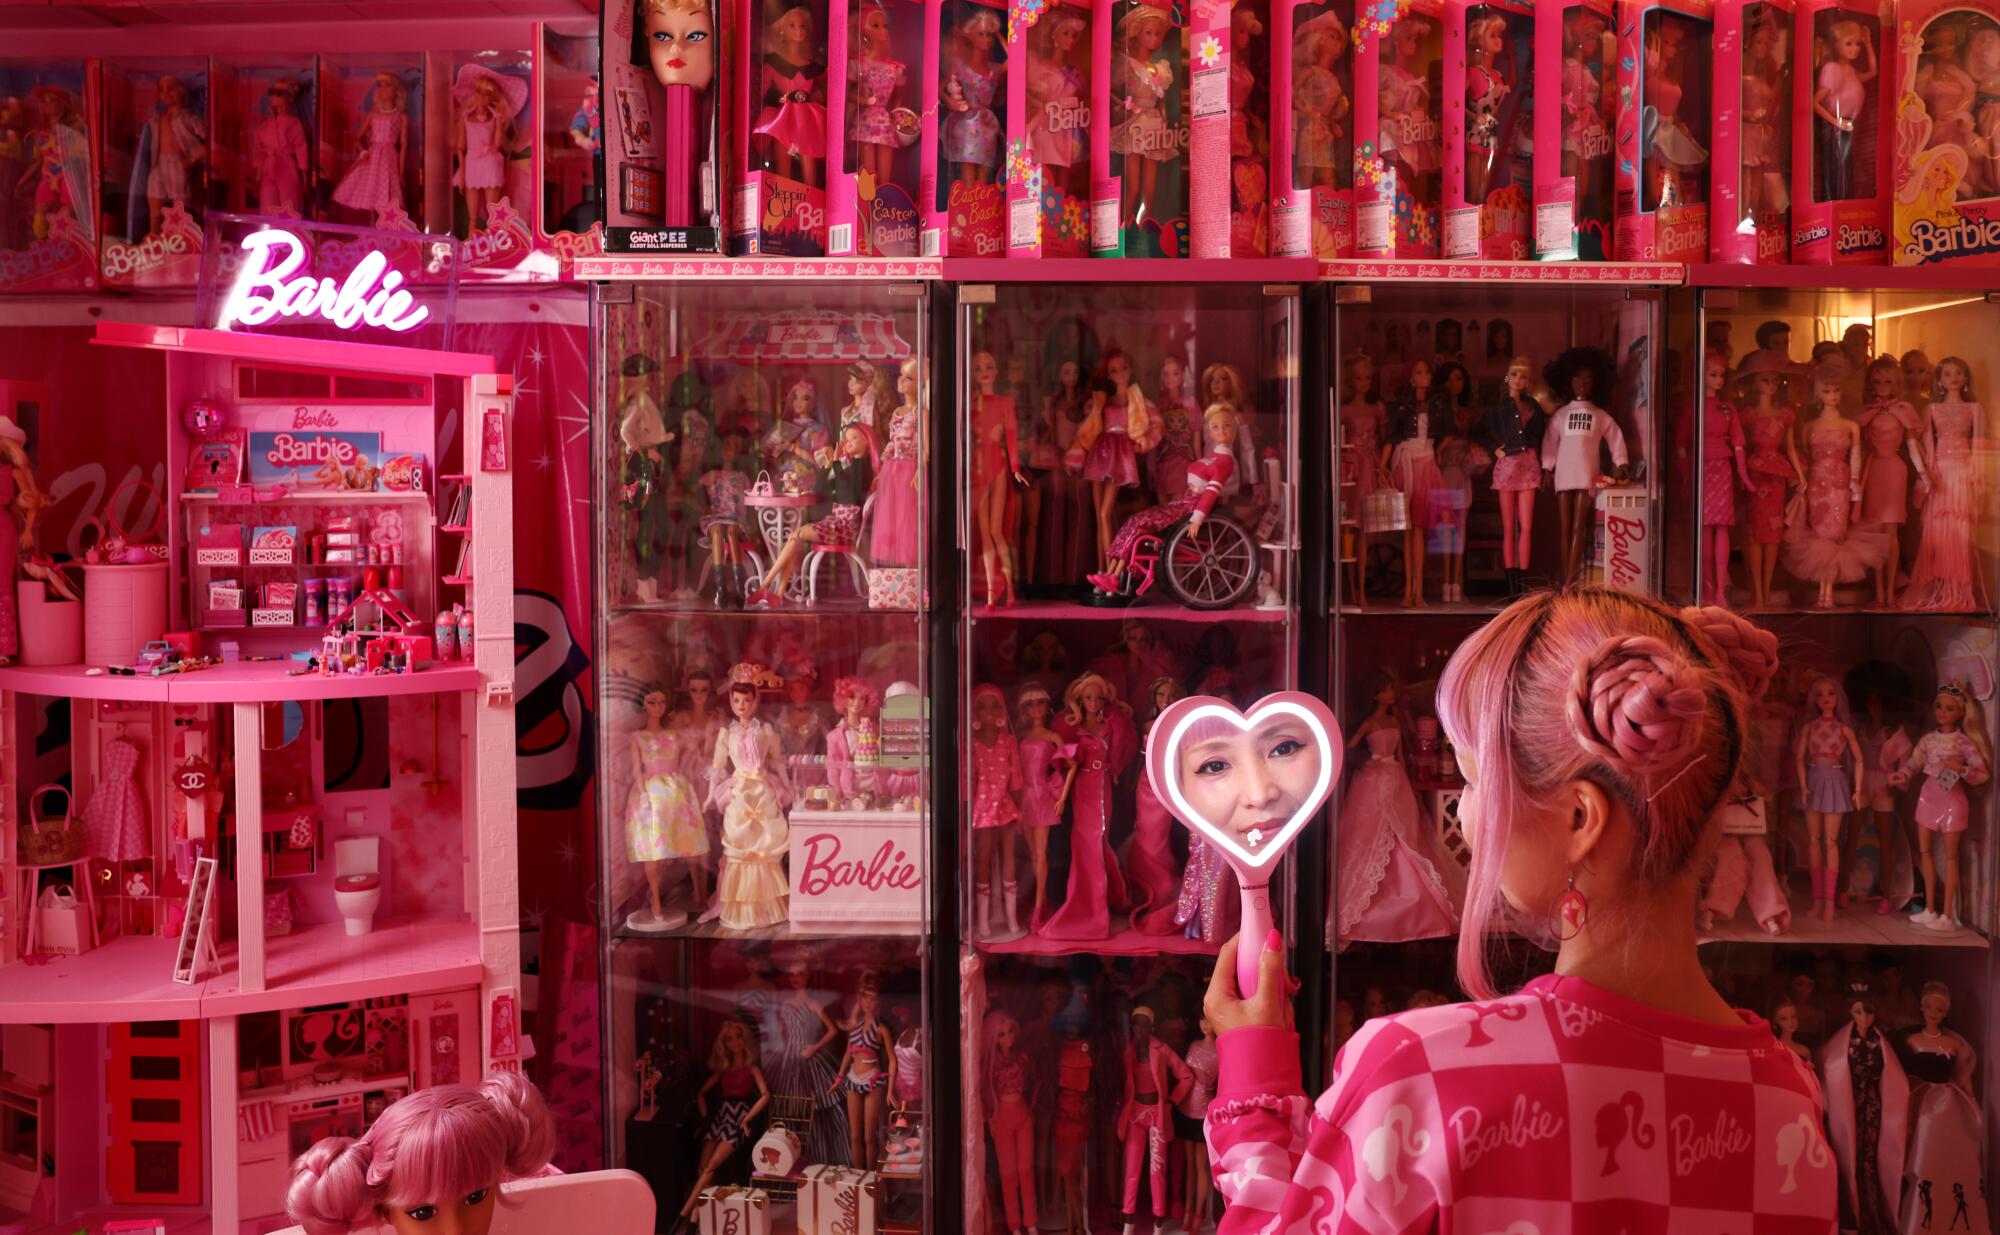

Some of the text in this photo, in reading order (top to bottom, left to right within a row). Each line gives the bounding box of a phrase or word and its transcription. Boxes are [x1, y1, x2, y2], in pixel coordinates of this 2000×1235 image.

[1130, 124, 1190, 154] Barbie
[951, 184, 995, 207] Easter
[795, 202, 824, 231] Ba
[629, 231, 687, 244] Giant PEZ
[875, 224, 917, 246] Barbie
[1793, 226, 1828, 246] Barbie
[1835, 222, 1883, 250] Barbie
[1904, 217, 2000, 257] Barbie
[105, 233, 186, 278] Barbie
[427, 229, 513, 274] Brbie
[224, 229, 430, 332] Barbie
[581, 262, 939, 275] Barbie Barbie Barbie Barbie Barbie Barbie Barbie Barbie Barbie Barbie Barbie Barbie
[780, 326, 824, 342] Barbie
[292, 406, 339, 429] Barbie
[1568, 421, 1592, 431] OFTEN
[1569, 412, 1593, 422] DREAM
[267, 433, 353, 464] Barbie
[1607, 515, 1646, 587] Barbie
[798, 832, 921, 896] Barbie
[1449, 1094, 1563, 1172] Barbie
[1670, 1109, 1752, 1177] Barbie
[722, 1208, 741, 1235] B
